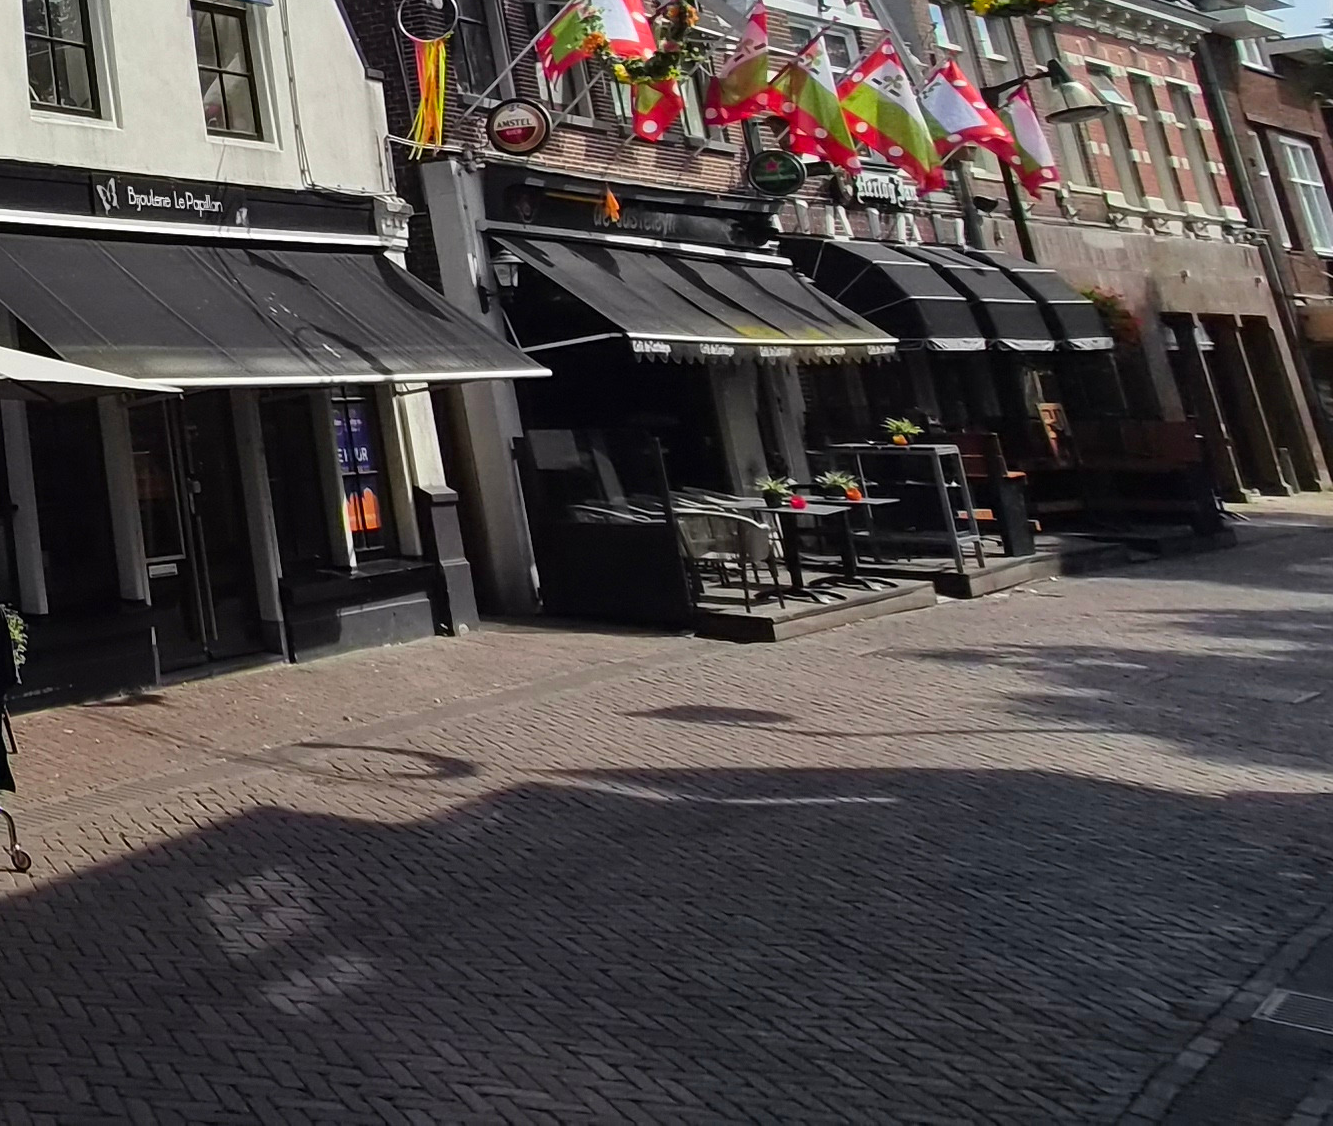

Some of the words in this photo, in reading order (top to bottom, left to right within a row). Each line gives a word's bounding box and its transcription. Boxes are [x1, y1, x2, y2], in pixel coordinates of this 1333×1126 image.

[497, 119, 532, 128] AMSTEL
[173, 190, 186, 210] Le
[185, 192, 224, 218] Papillon
